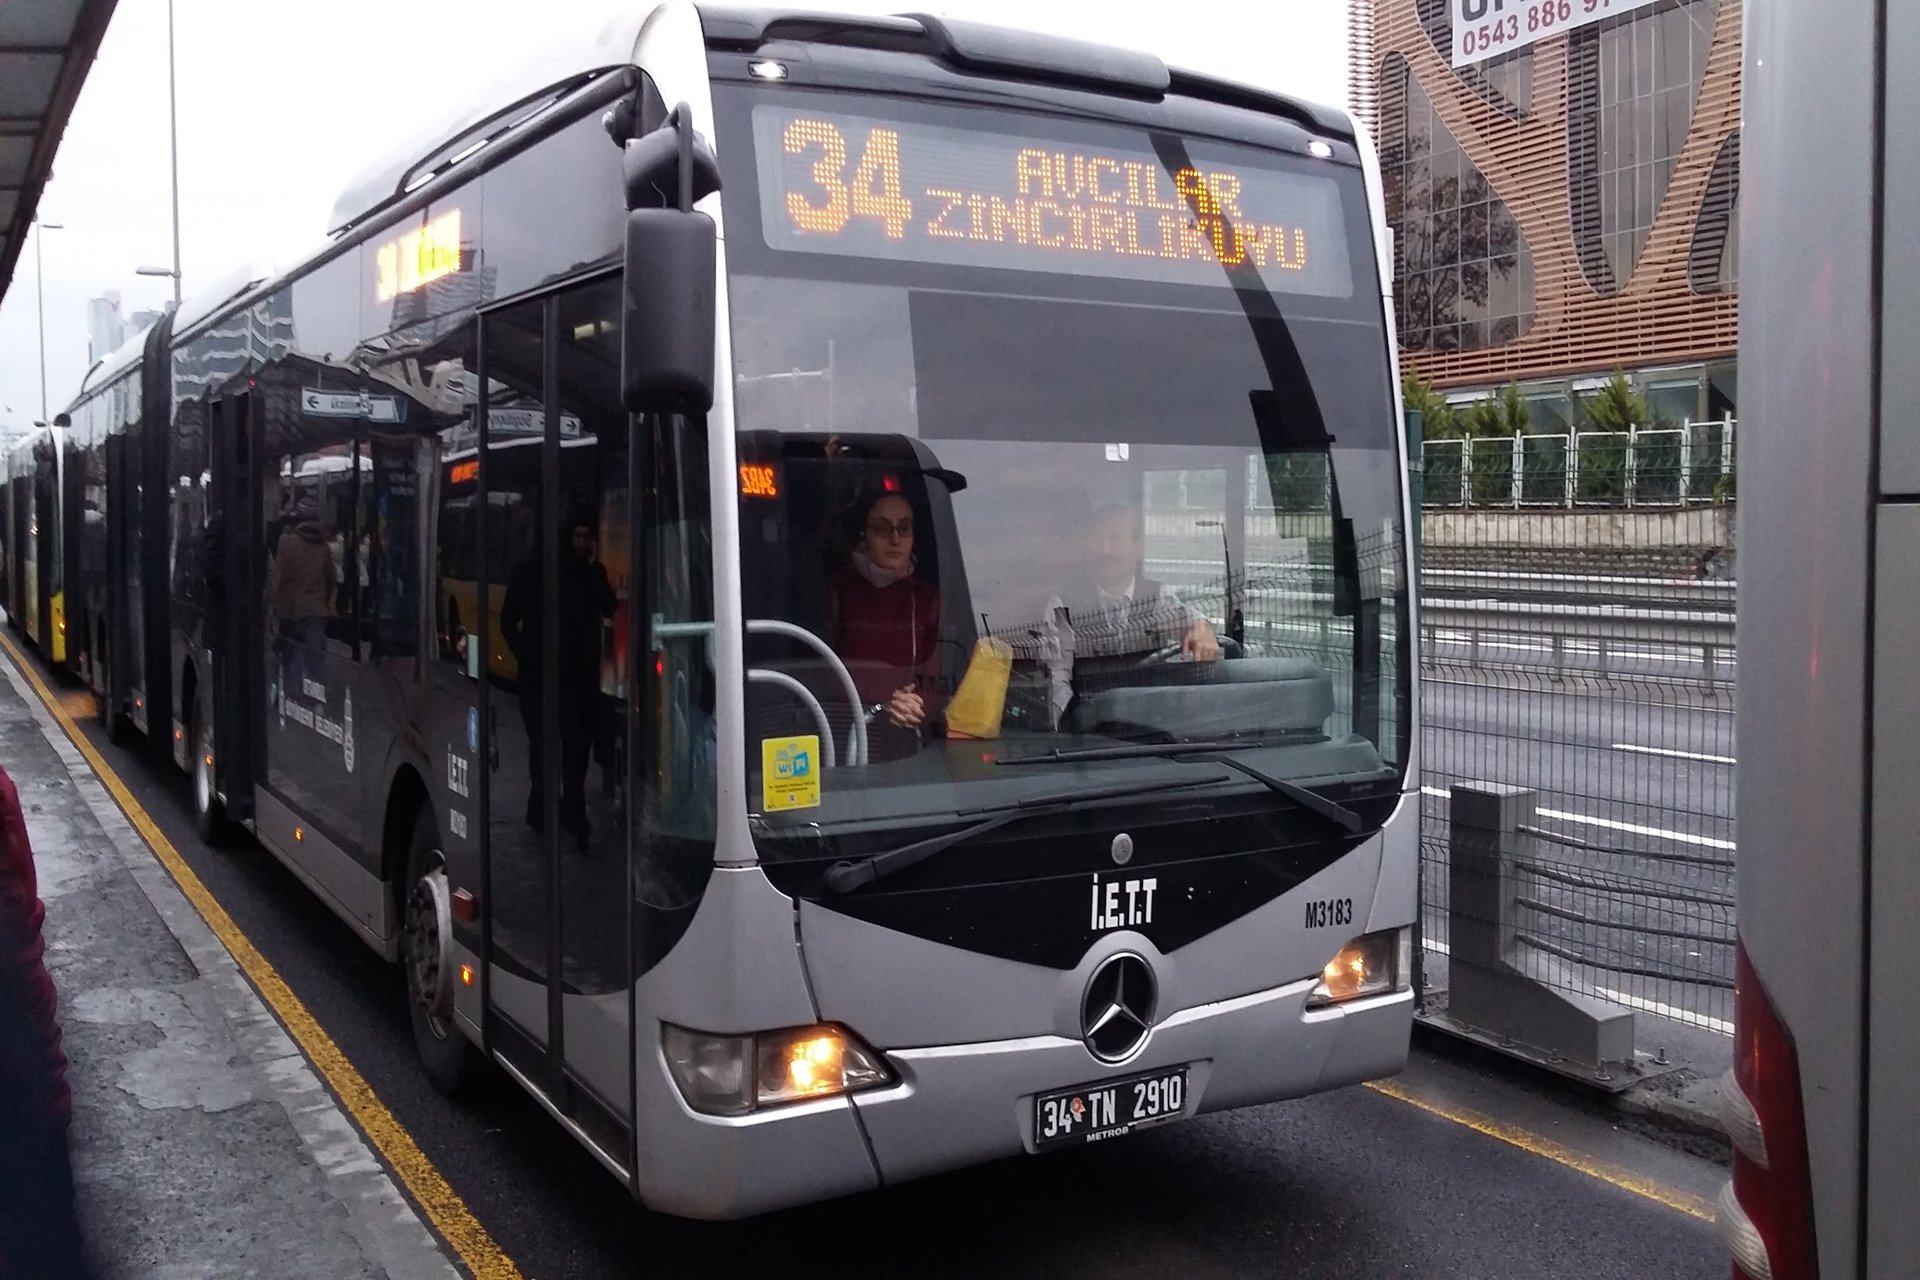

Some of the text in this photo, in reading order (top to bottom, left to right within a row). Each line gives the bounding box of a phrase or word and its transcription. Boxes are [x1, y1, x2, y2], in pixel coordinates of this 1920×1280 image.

[1463, 15, 1518, 56] 0543
[1528, 0, 1571, 32] 886
[782, 118, 913, 240] 34
[1017, 148, 1243, 217] AVCILAR
[1305, 898, 1352, 929] M3183
[1043, 1075, 1182, 1137] 34 TN 2910
